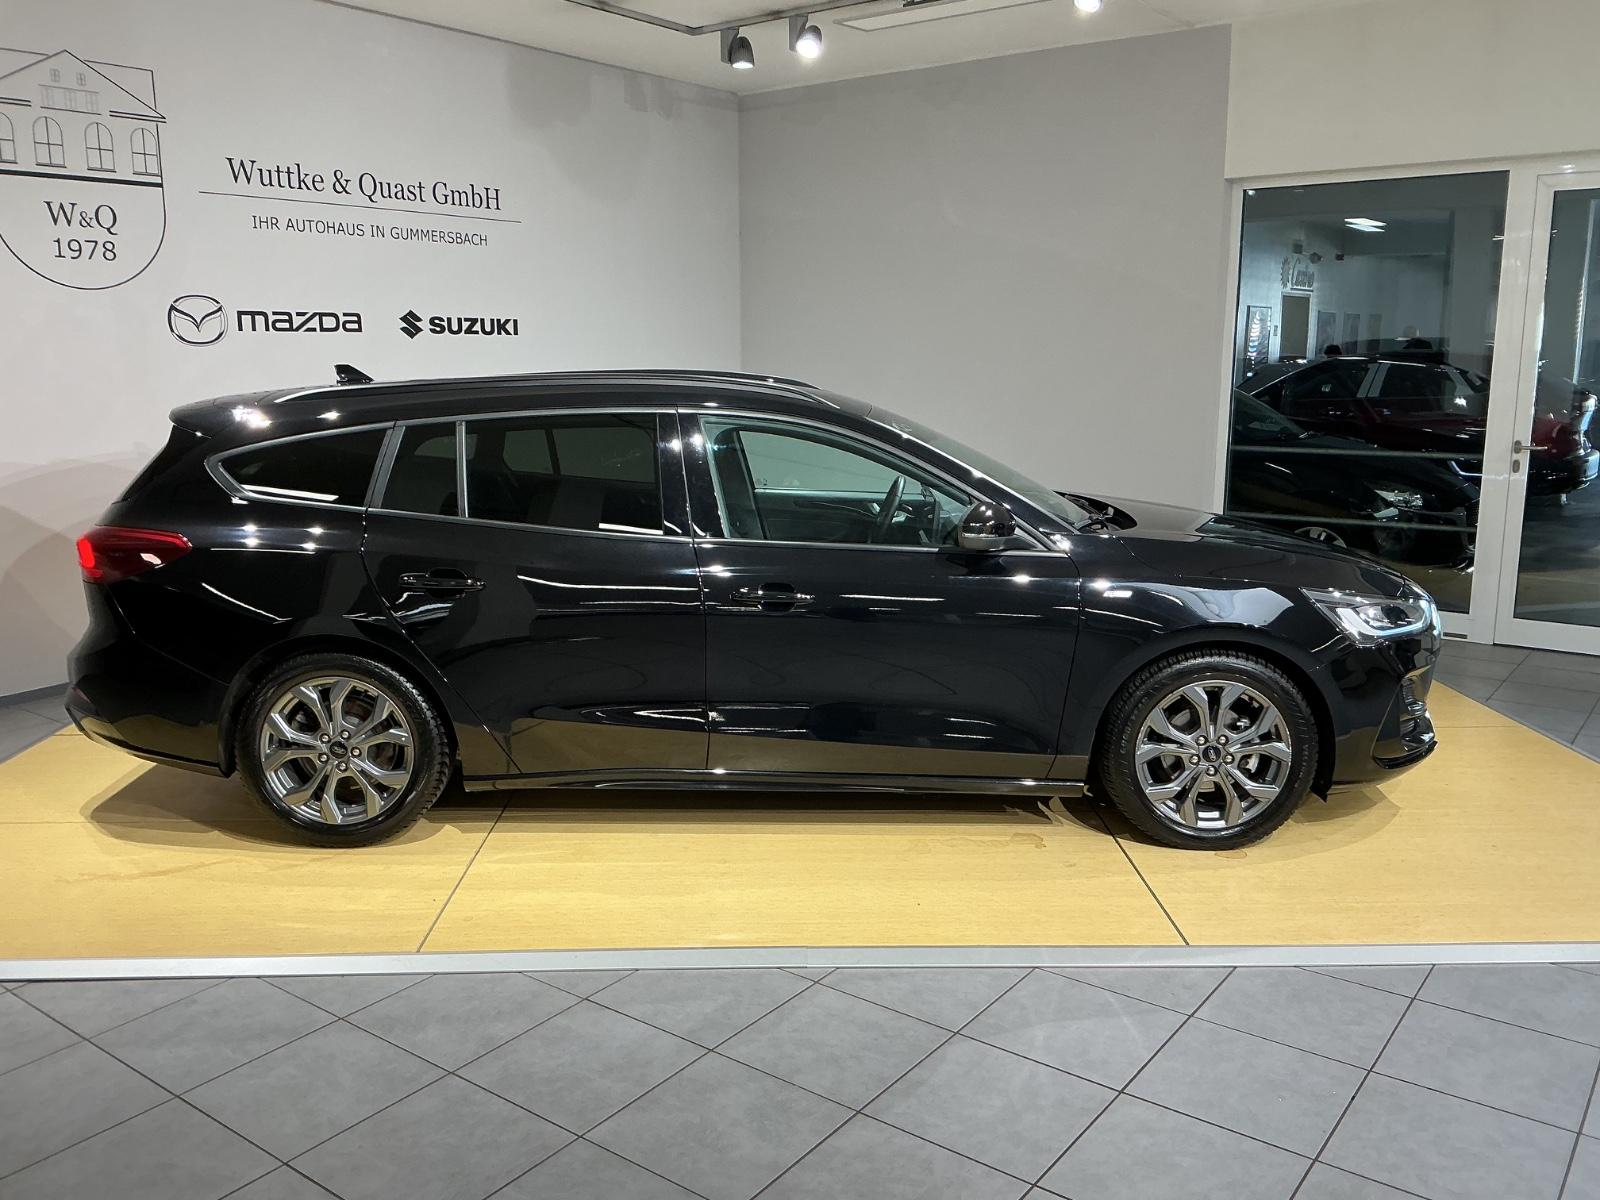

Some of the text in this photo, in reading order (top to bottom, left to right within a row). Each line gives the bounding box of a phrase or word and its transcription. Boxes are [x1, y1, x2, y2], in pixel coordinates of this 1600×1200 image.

[225, 157, 502, 211] Wuttke & Quast GmbH
[43, 201, 118, 235] W&Q
[252, 215, 488, 246] IHR AUTOHAUS IN GUMMERSBACH
[53, 238, 118, 261] 1978
[429, 316, 519, 335] SUZUKI
